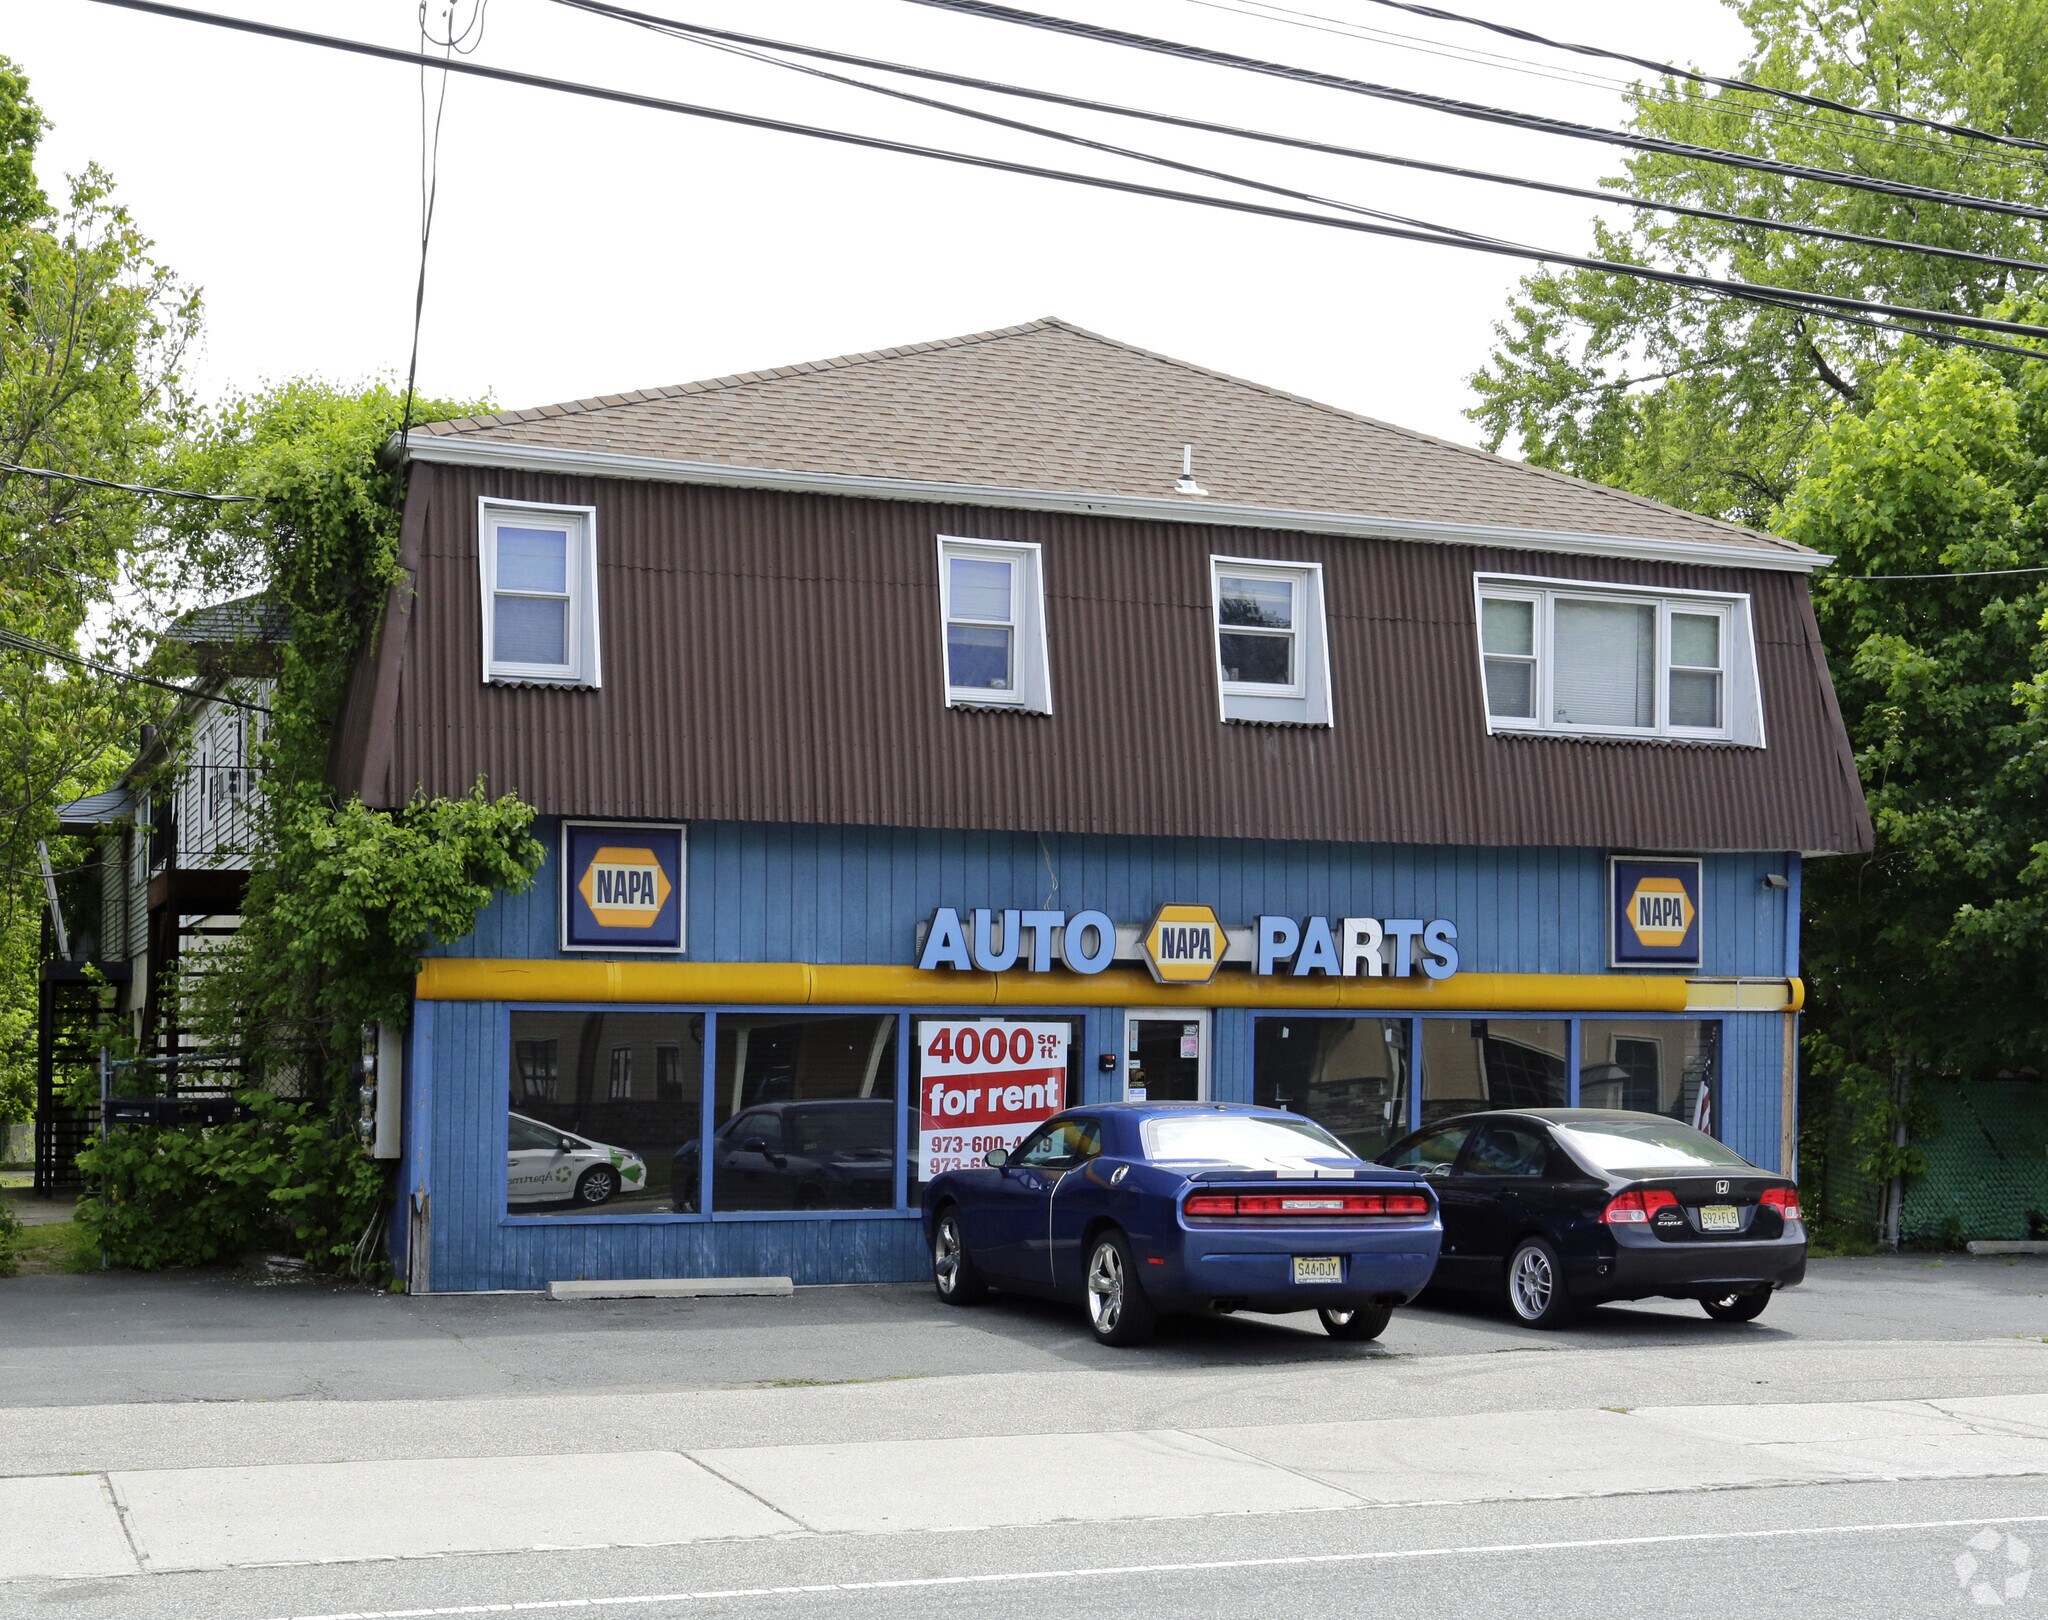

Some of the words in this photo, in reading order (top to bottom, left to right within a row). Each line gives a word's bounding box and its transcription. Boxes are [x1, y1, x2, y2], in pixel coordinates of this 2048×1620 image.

[597, 869, 655, 905] NAPA
[1639, 897, 1683, 927] NAPA
[917, 907, 1117, 975] AUTO
[1161, 927, 1212, 960] NAPA
[1257, 914, 1460, 980] PARTS
[928, 1027, 1035, 1065] 4000
[1037, 1033, 1061, 1049] sq.
[1040, 1046, 1058, 1059] ft.
[929, 1083, 981, 1117] for
[988, 1077, 1059, 1113] rent
